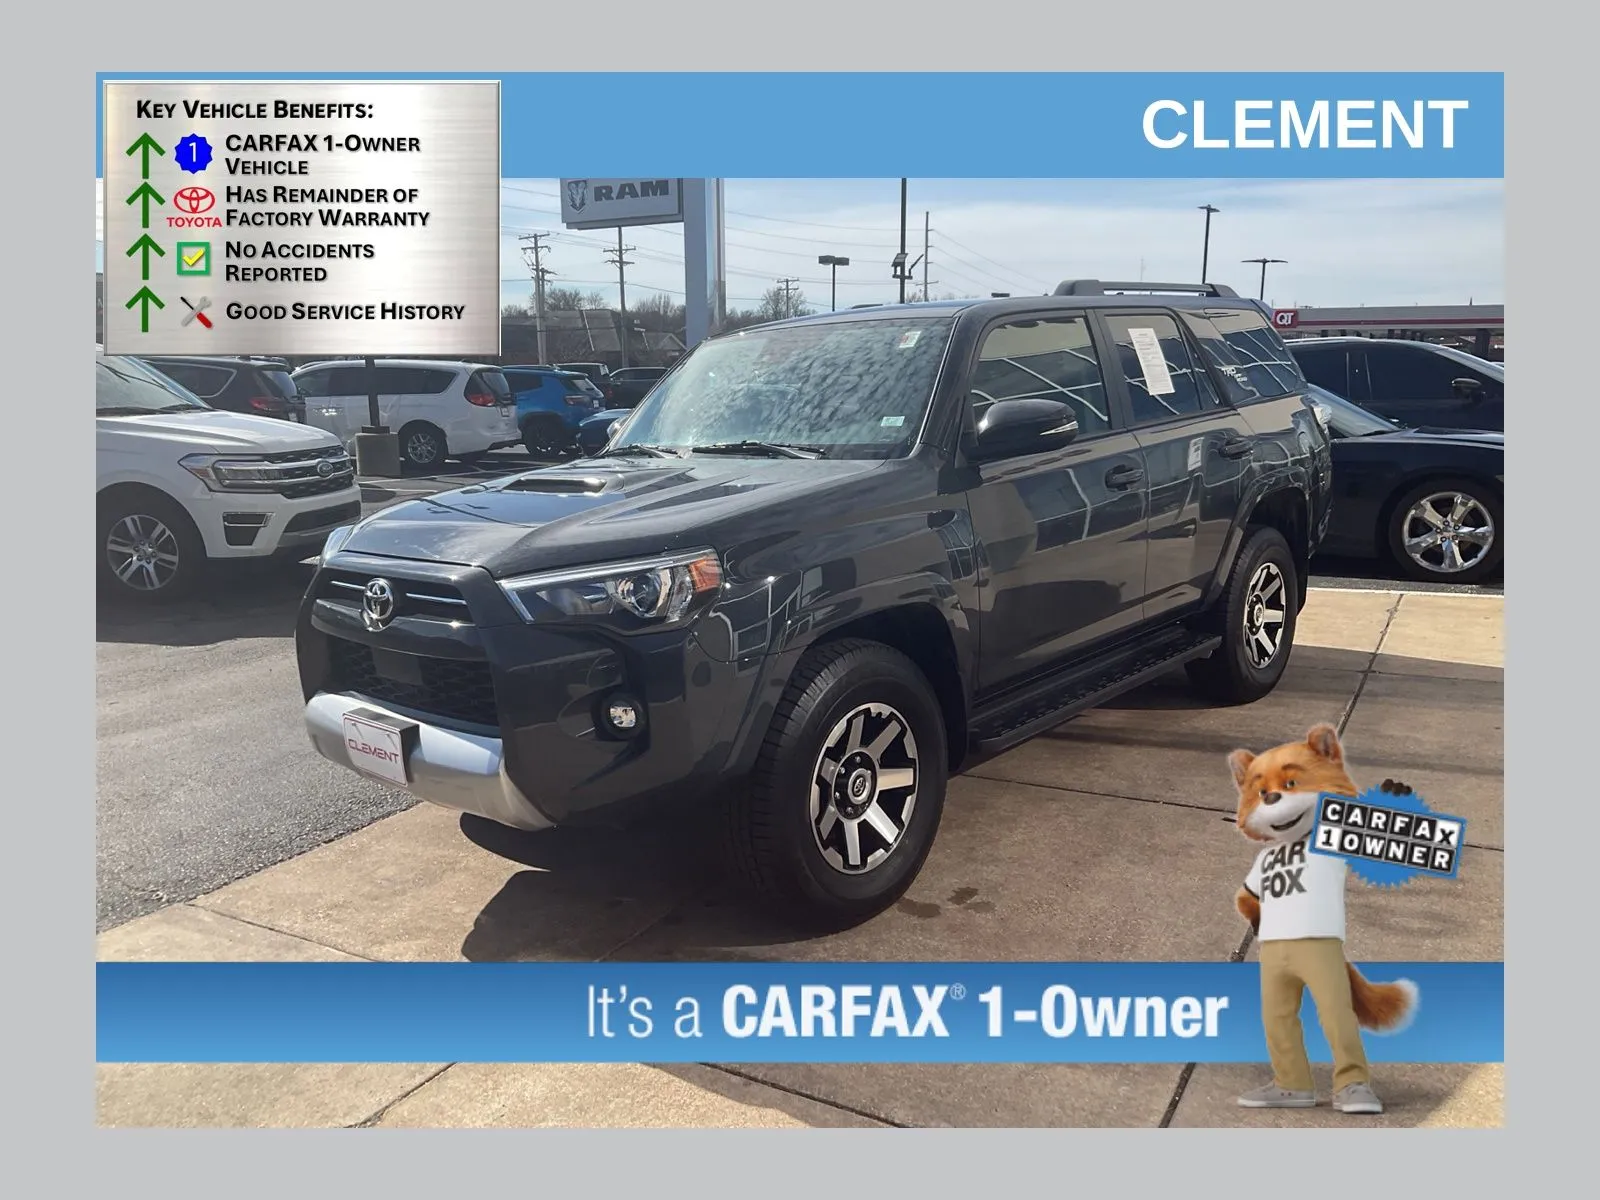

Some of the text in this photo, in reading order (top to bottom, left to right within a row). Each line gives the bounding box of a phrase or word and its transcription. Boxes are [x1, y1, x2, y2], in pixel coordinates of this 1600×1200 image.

[593, 179, 669, 202] RAM
[1276, 311, 1295, 326] QT
[348, 739, 399, 763] CLEMENT
